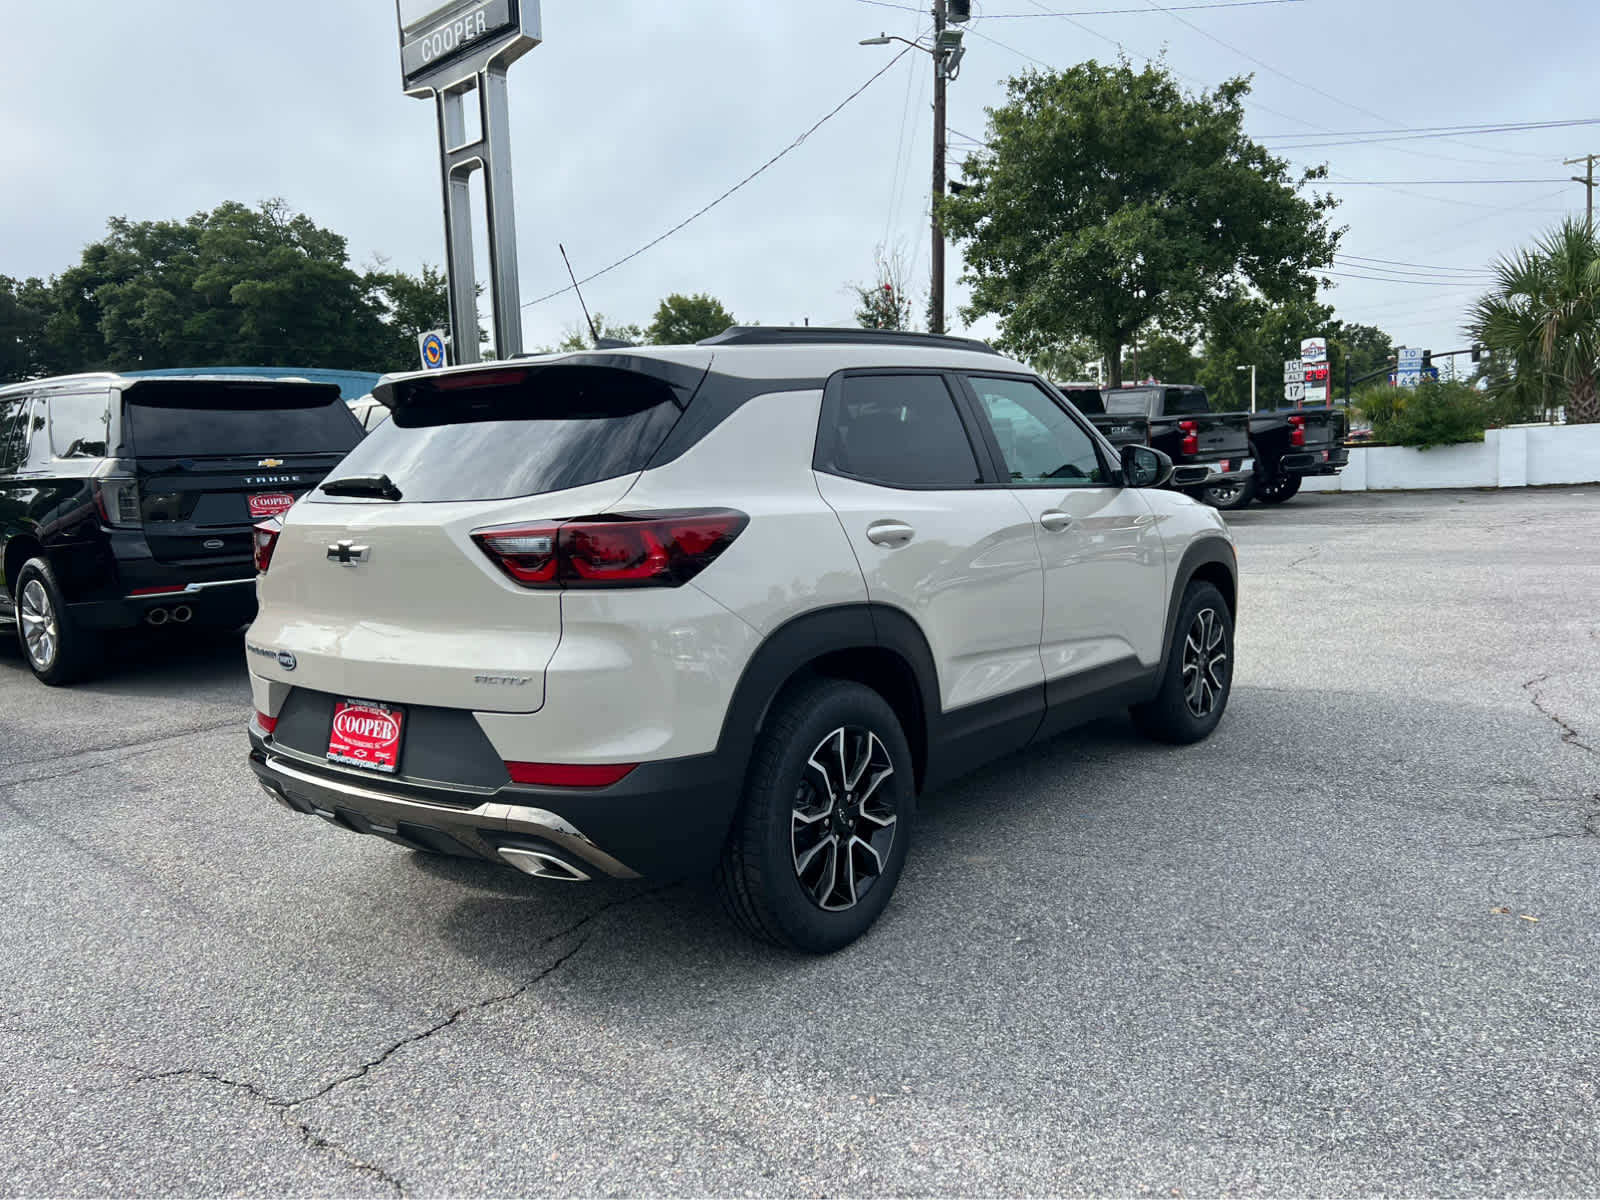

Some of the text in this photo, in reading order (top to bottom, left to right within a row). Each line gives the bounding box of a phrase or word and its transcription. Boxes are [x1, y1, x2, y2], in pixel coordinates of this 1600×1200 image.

[421, 10, 487, 62] COOPER
[1403, 350, 1417, 358] TO
[1287, 361, 1302, 371] JCT
[1287, 373, 1301, 381] ALT
[1289, 385, 1301, 398] 17
[243, 475, 300, 484] TAHOE
[253, 497, 292, 506] COOPER
[337, 714, 393, 740] COOPER
